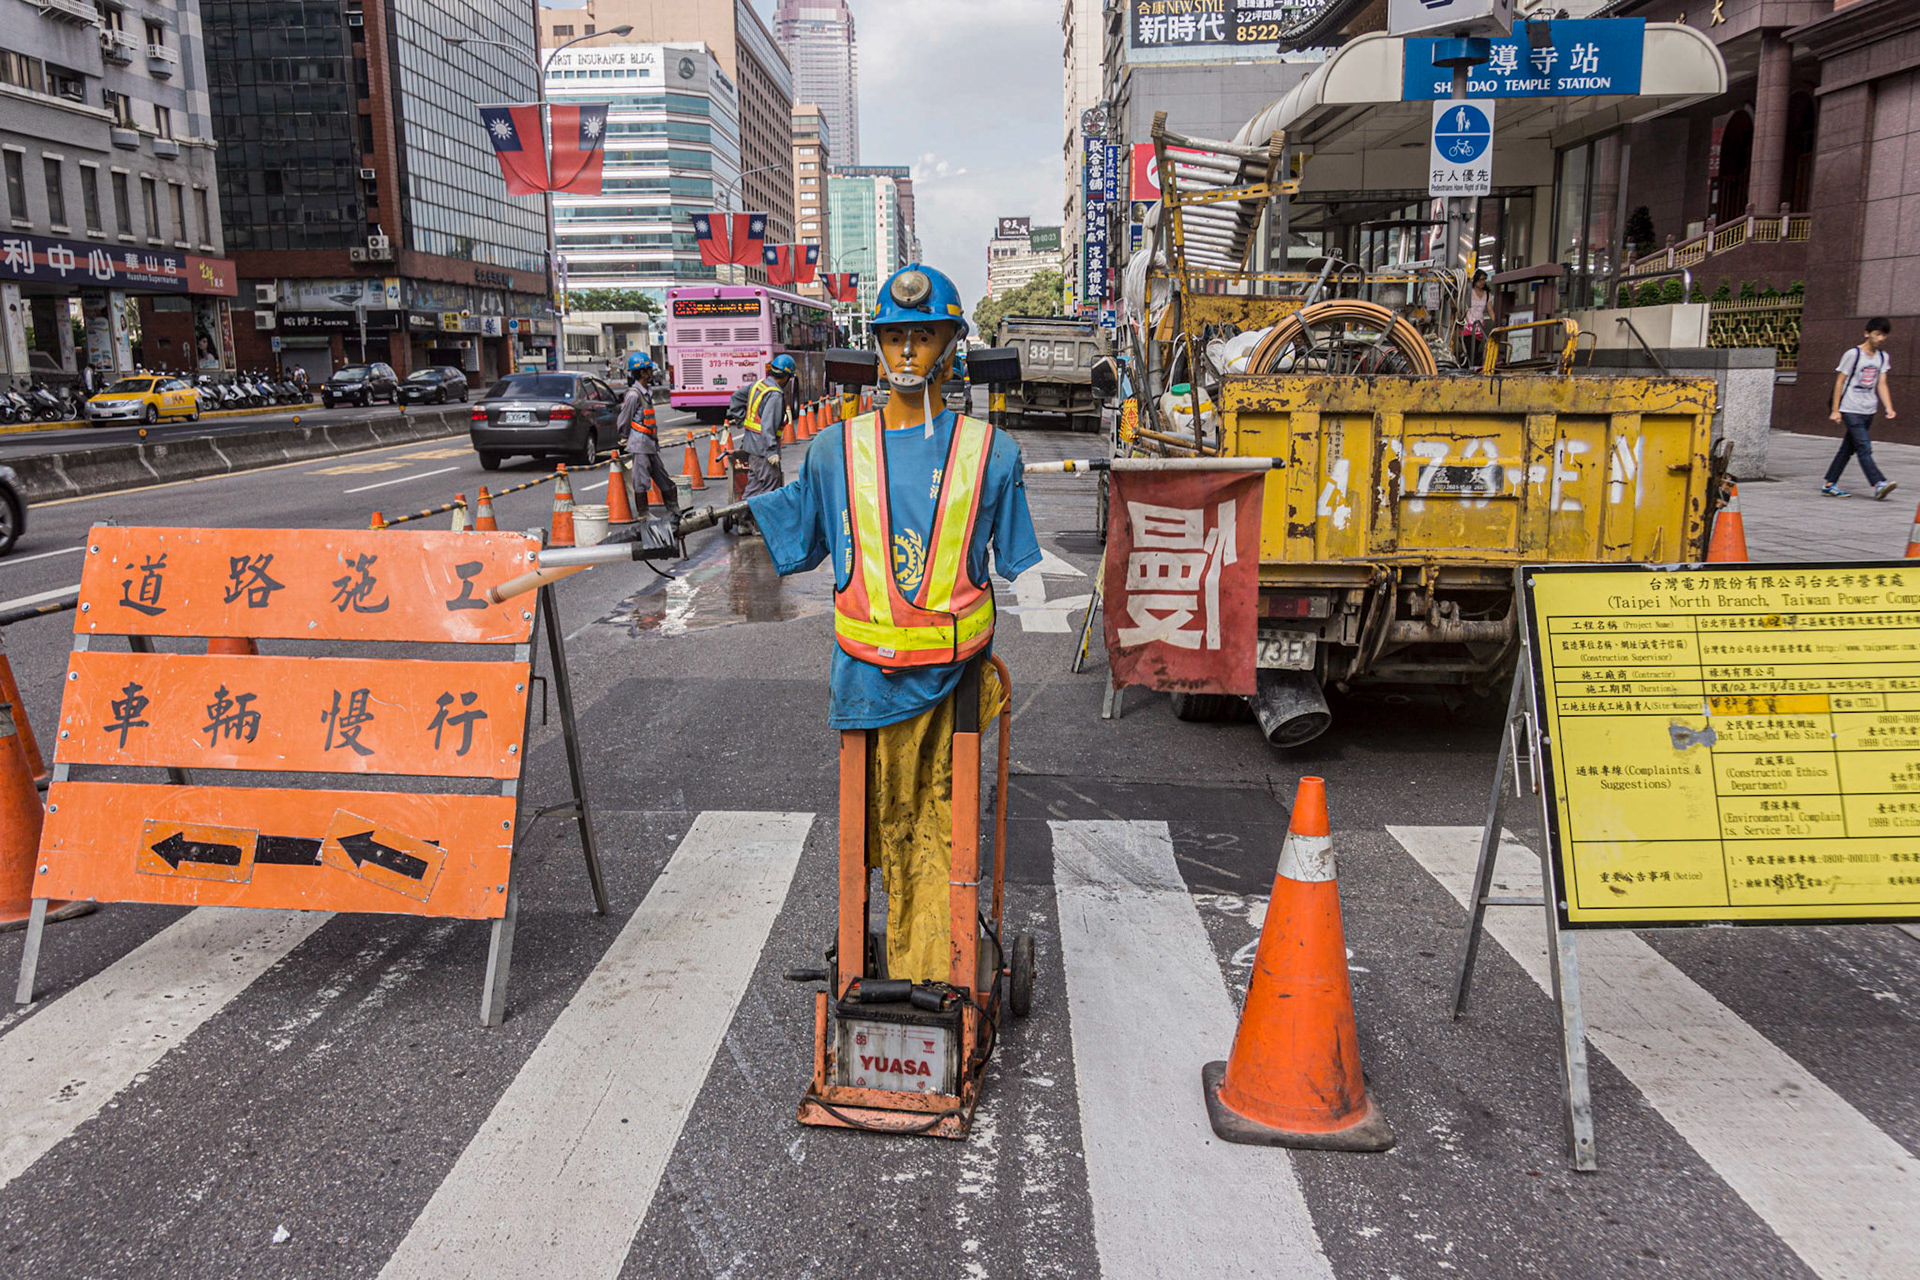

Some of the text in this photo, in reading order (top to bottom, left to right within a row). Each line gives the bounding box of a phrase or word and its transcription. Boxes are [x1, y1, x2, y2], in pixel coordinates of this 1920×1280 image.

[1138, 13, 1226, 44] 新時代
[577, 53, 626, 65] INSURANCE
[1466, 42, 1600, 77] 導寺站
[1504, 78, 1551, 92] TEMPLE
[1557, 76, 1611, 90] STATION
[1432, 168, 1489, 182] 行人優先
[1464, 184, 1474, 192] Right
[3, 239, 116, 280] 利中心
[124, 253, 177, 275] 華山店
[1087, 246, 1103, 297] 汽車借款
[126, 272, 179, 285] Huashan Supermarket
[1101, 312, 1109, 322] P
[1029, 345, 1074, 361] 38-EL
[709, 360, 734, 368] 373-FR
[119, 552, 490, 617] 道路施工
[1607, 594, 1661, 611] (Taipei
[1669, 593, 1711, 608] North
[1781, 592, 1831, 606] Taiwan
[1837, 591, 1880, 606] Power
[1571, 621, 1618, 631] 工程名稱
[1623, 621, 1652, 630] (Project
[1580, 652, 1673, 663] (Construction Supervisor)
[1582, 670, 1676, 681] 施工廠商 (Contractor)
[1586, 683, 1632, 694] 施工期間
[102, 681, 489, 757] 車輛慢行
[1695, 765, 1702, 775] &
[1726, 766, 1828, 778] (Construction Ethics
[1600, 778, 1672, 790] Suggestions)
[1731, 780, 1787, 791] Department)
[1724, 812, 1795, 823] (Environmental
[1743, 825, 1782, 836] Service
[1673, 872, 1703, 881] (Notice)
[859, 1054, 932, 1077] YUASA
